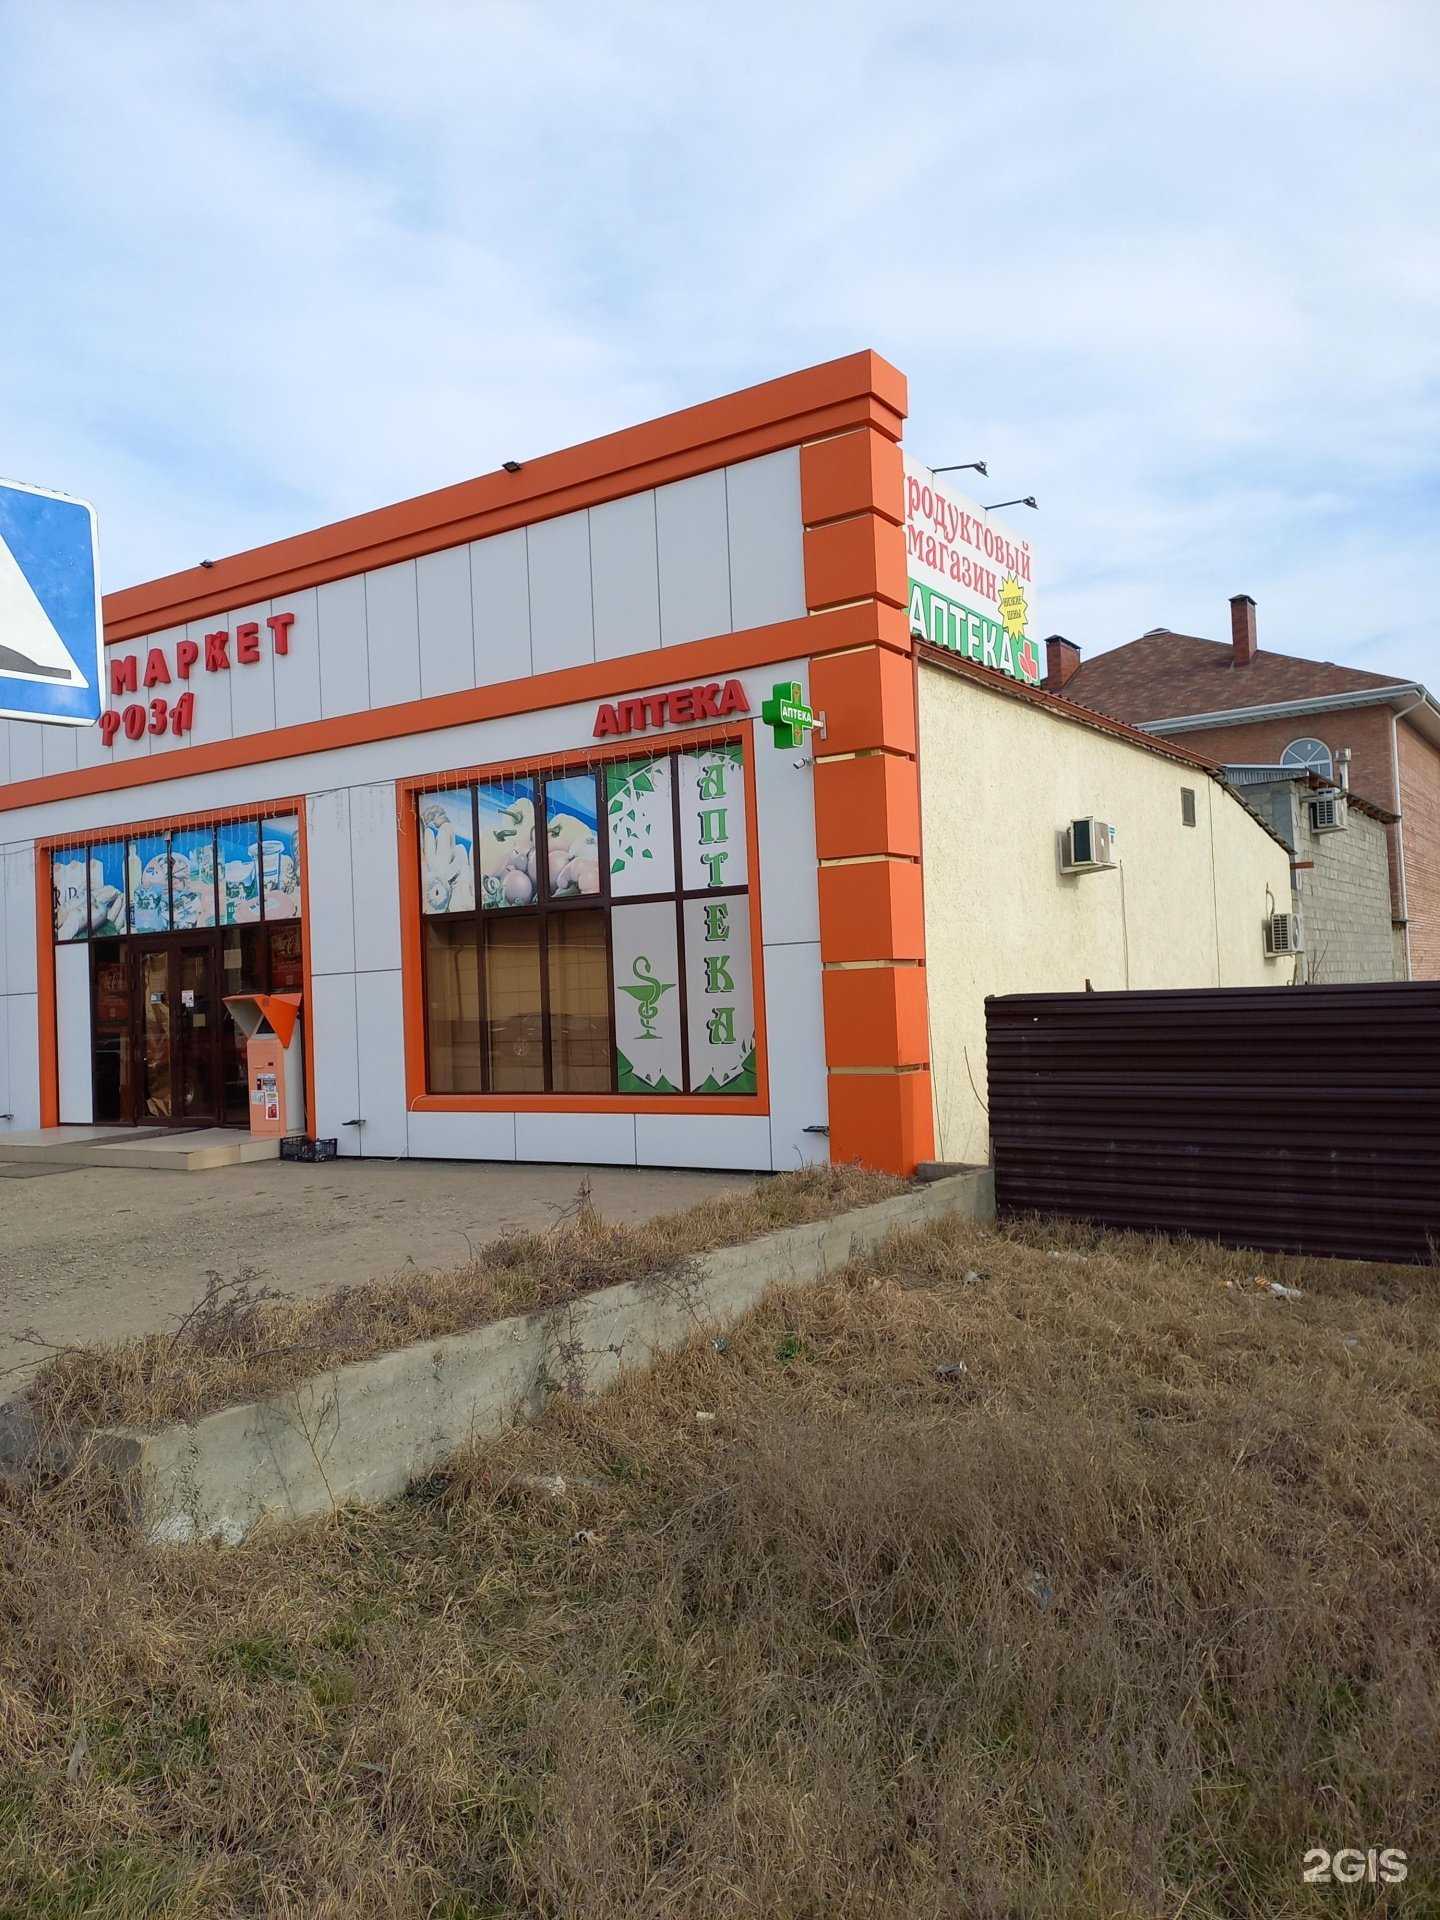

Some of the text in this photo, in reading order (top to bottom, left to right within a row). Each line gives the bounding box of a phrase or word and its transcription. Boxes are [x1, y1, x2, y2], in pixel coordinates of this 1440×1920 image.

[907, 476, 1032, 582] родуктовый
[907, 524, 998, 603] магазин
[110, 612, 295, 696] МАРКЕТ
[909, 583, 1016, 676] АПТЕКА
[98, 691, 195, 747] РОЗА
[592, 679, 751, 738] АПТЕКА
[782, 705, 812, 723] АПТЕКА
[697, 762, 738, 1046] АПТЕКА
